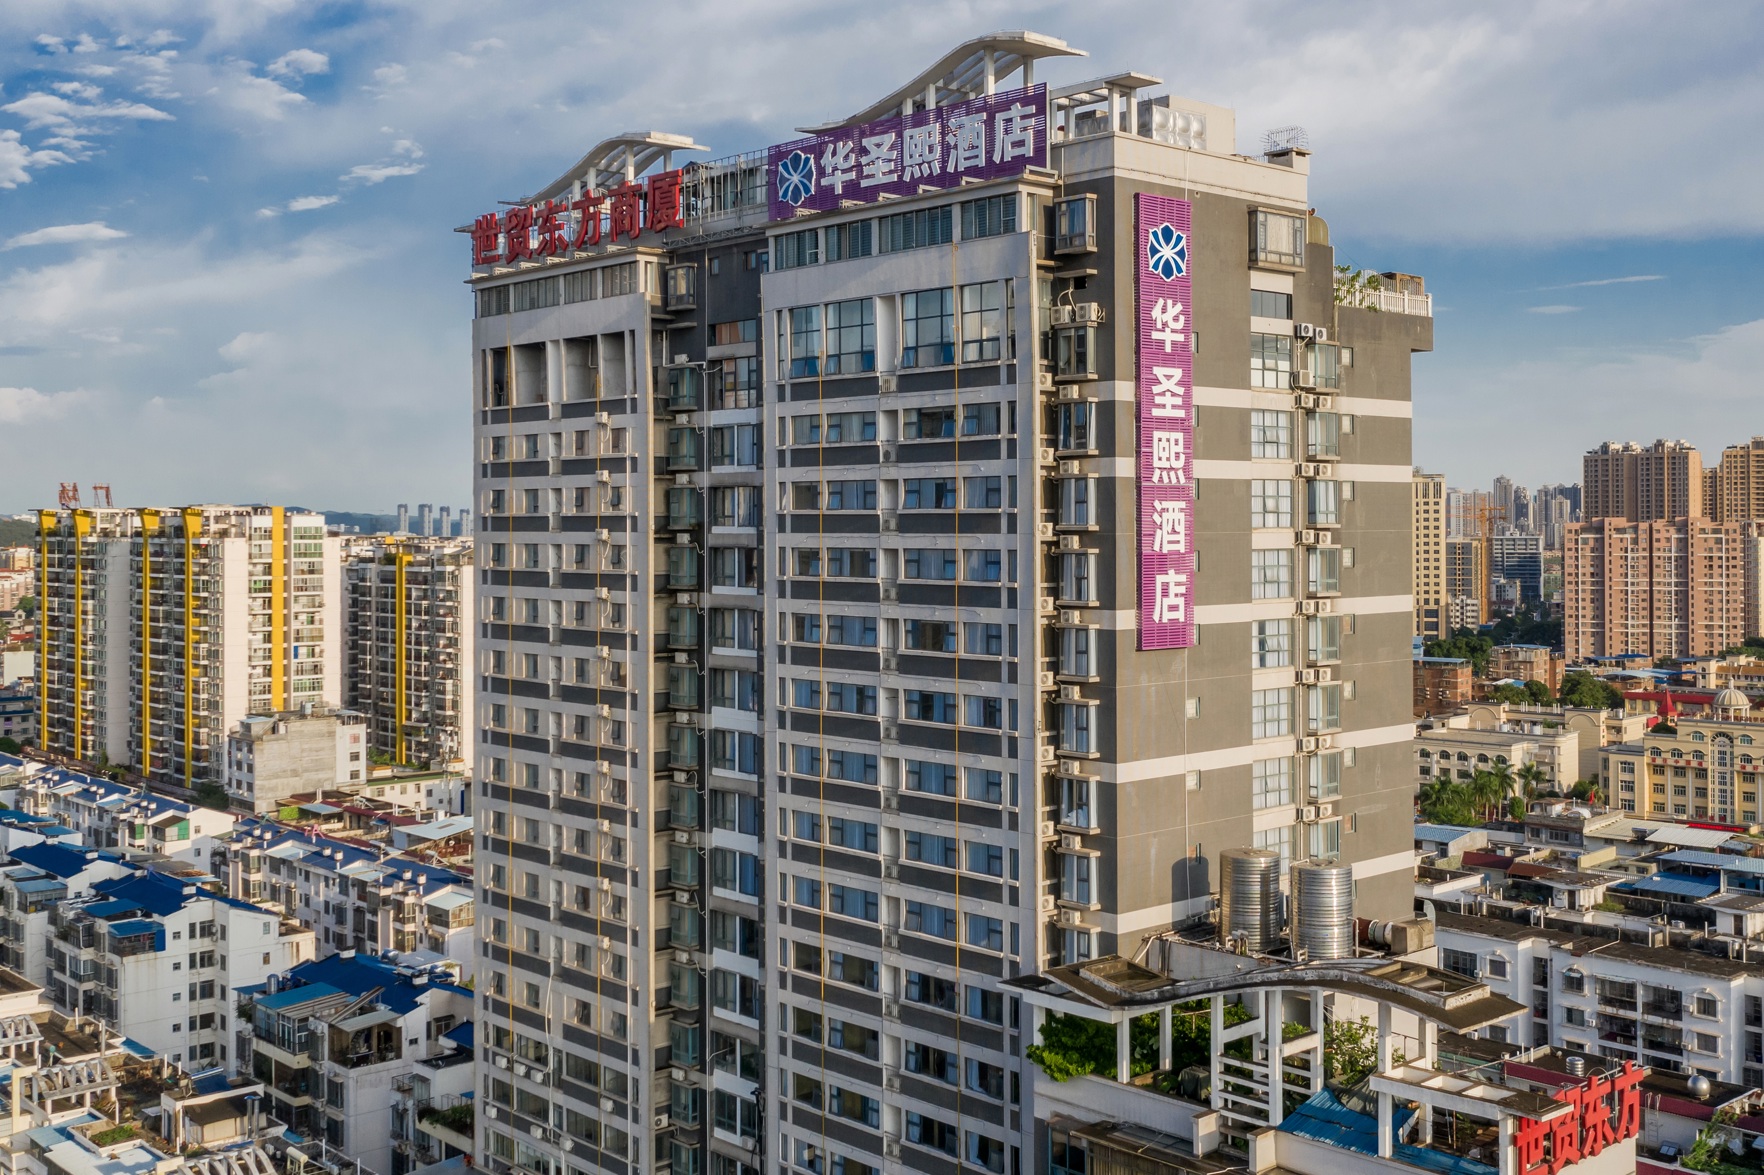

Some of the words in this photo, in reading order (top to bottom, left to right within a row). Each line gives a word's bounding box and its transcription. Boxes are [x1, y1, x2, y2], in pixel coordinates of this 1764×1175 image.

[820, 102, 1036, 195] 华圣熙酒店
[471, 168, 684, 266] 世贸东方商厦
[1150, 297, 1187, 624] 华圣熙酒店
